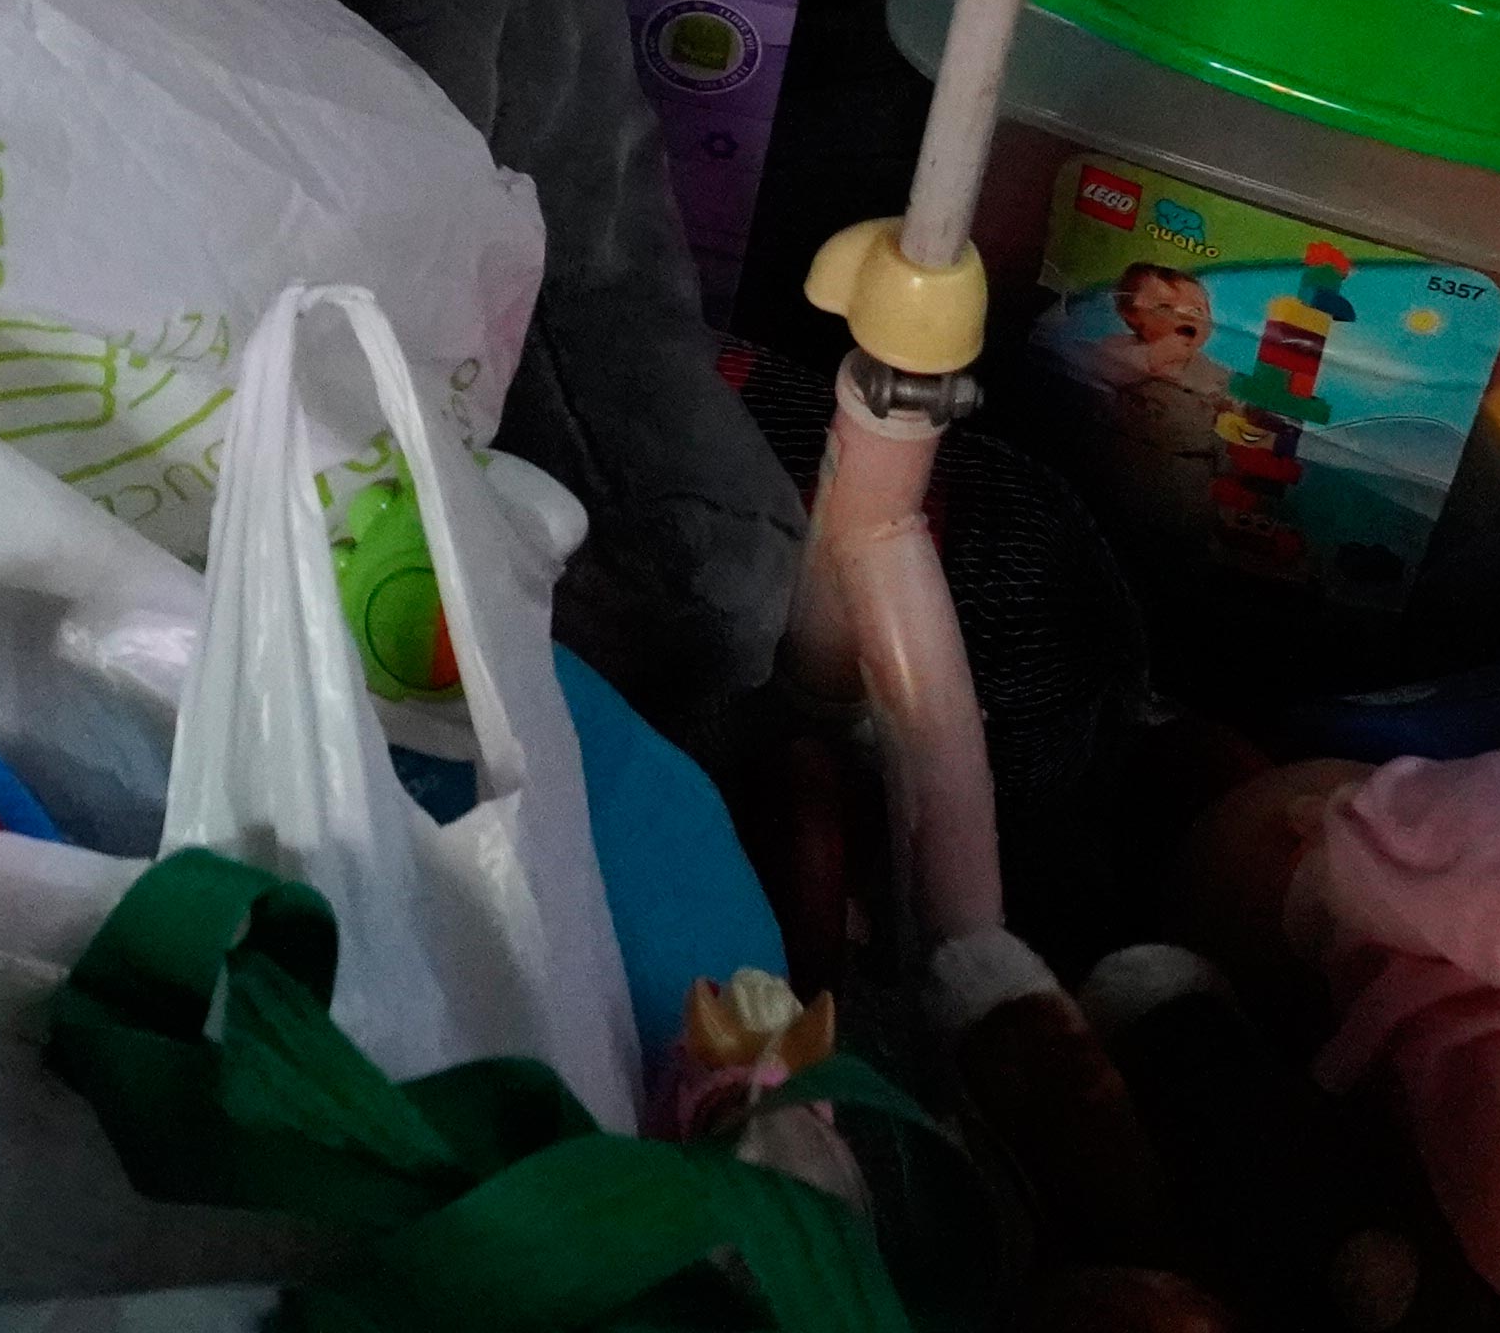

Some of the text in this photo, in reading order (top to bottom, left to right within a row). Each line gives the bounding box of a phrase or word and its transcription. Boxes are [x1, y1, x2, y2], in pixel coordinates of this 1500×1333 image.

[1081, 180, 1135, 216] LEGO
[1144, 220, 1221, 260] quatro
[1425, 275, 1488, 303] 5357
